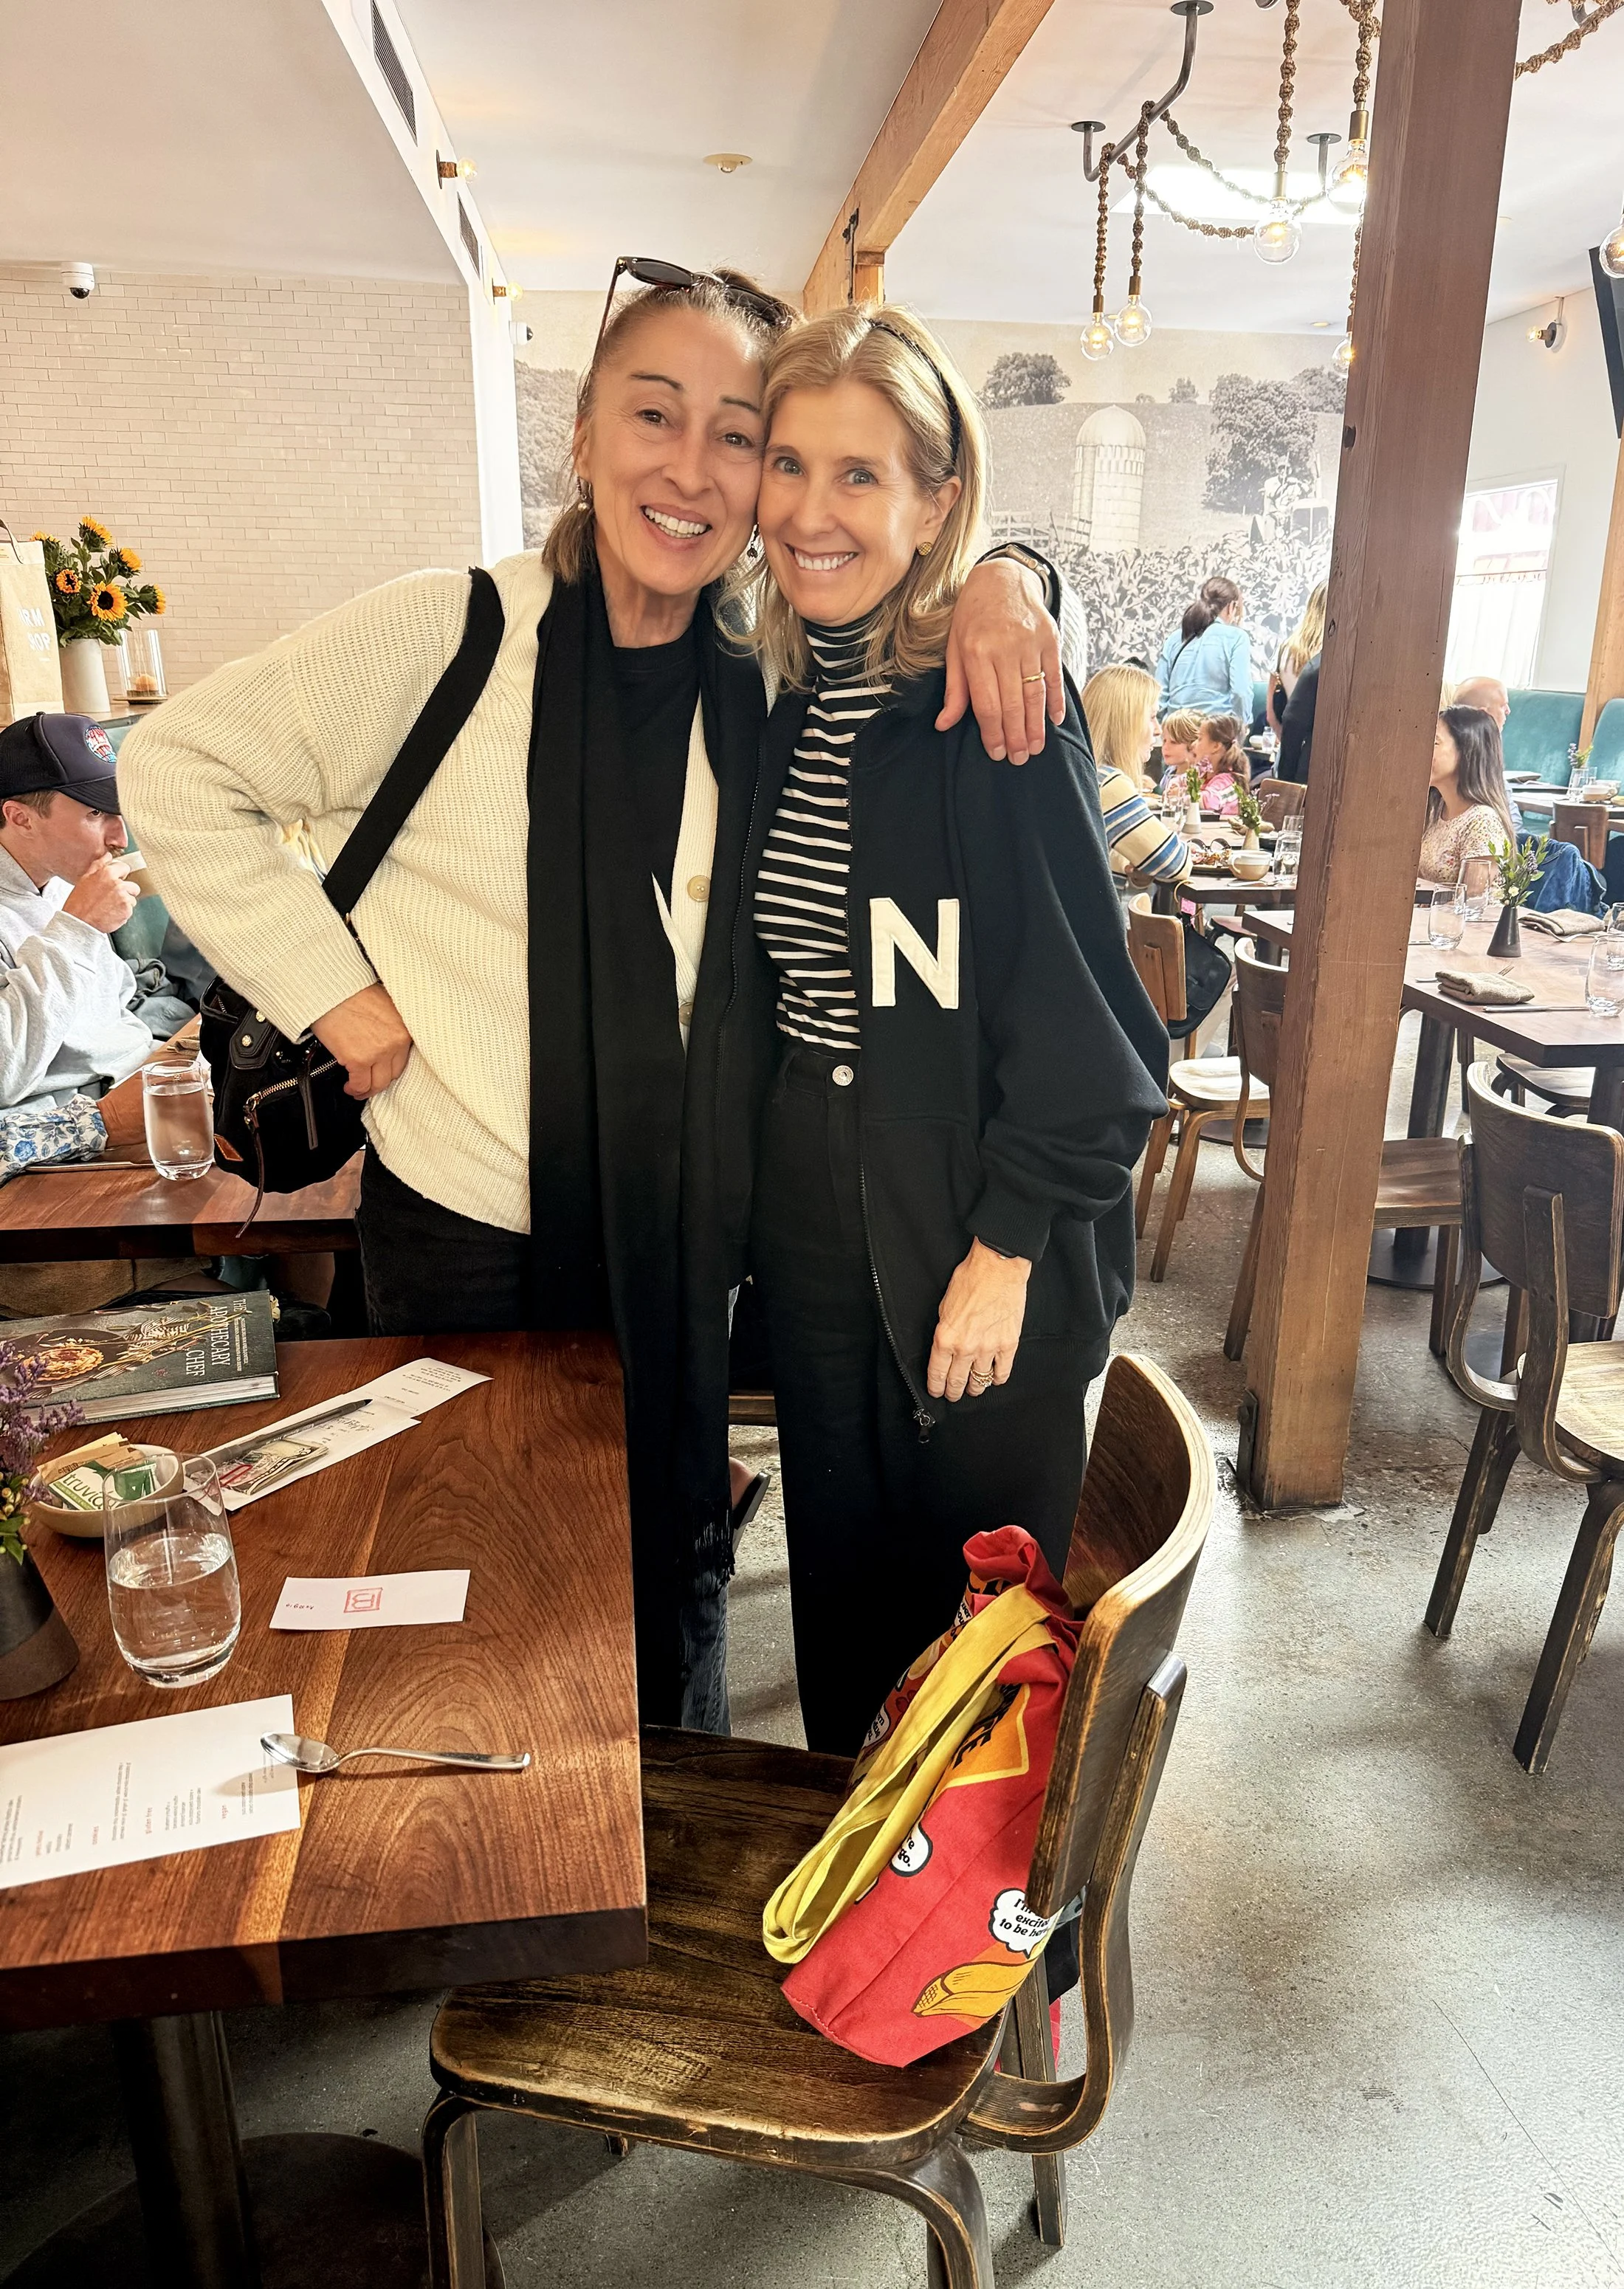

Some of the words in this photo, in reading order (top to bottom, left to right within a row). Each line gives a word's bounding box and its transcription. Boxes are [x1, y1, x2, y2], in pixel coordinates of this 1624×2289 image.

[870, 897, 960, 1009] N
[233, 1298, 247, 1312] THE
[186, 1349, 205, 1376] CHEF
[999, 1918, 1012, 1930] to
[1013, 1924, 1028, 1935] be
[1015, 1915, 1049, 1927] excite
